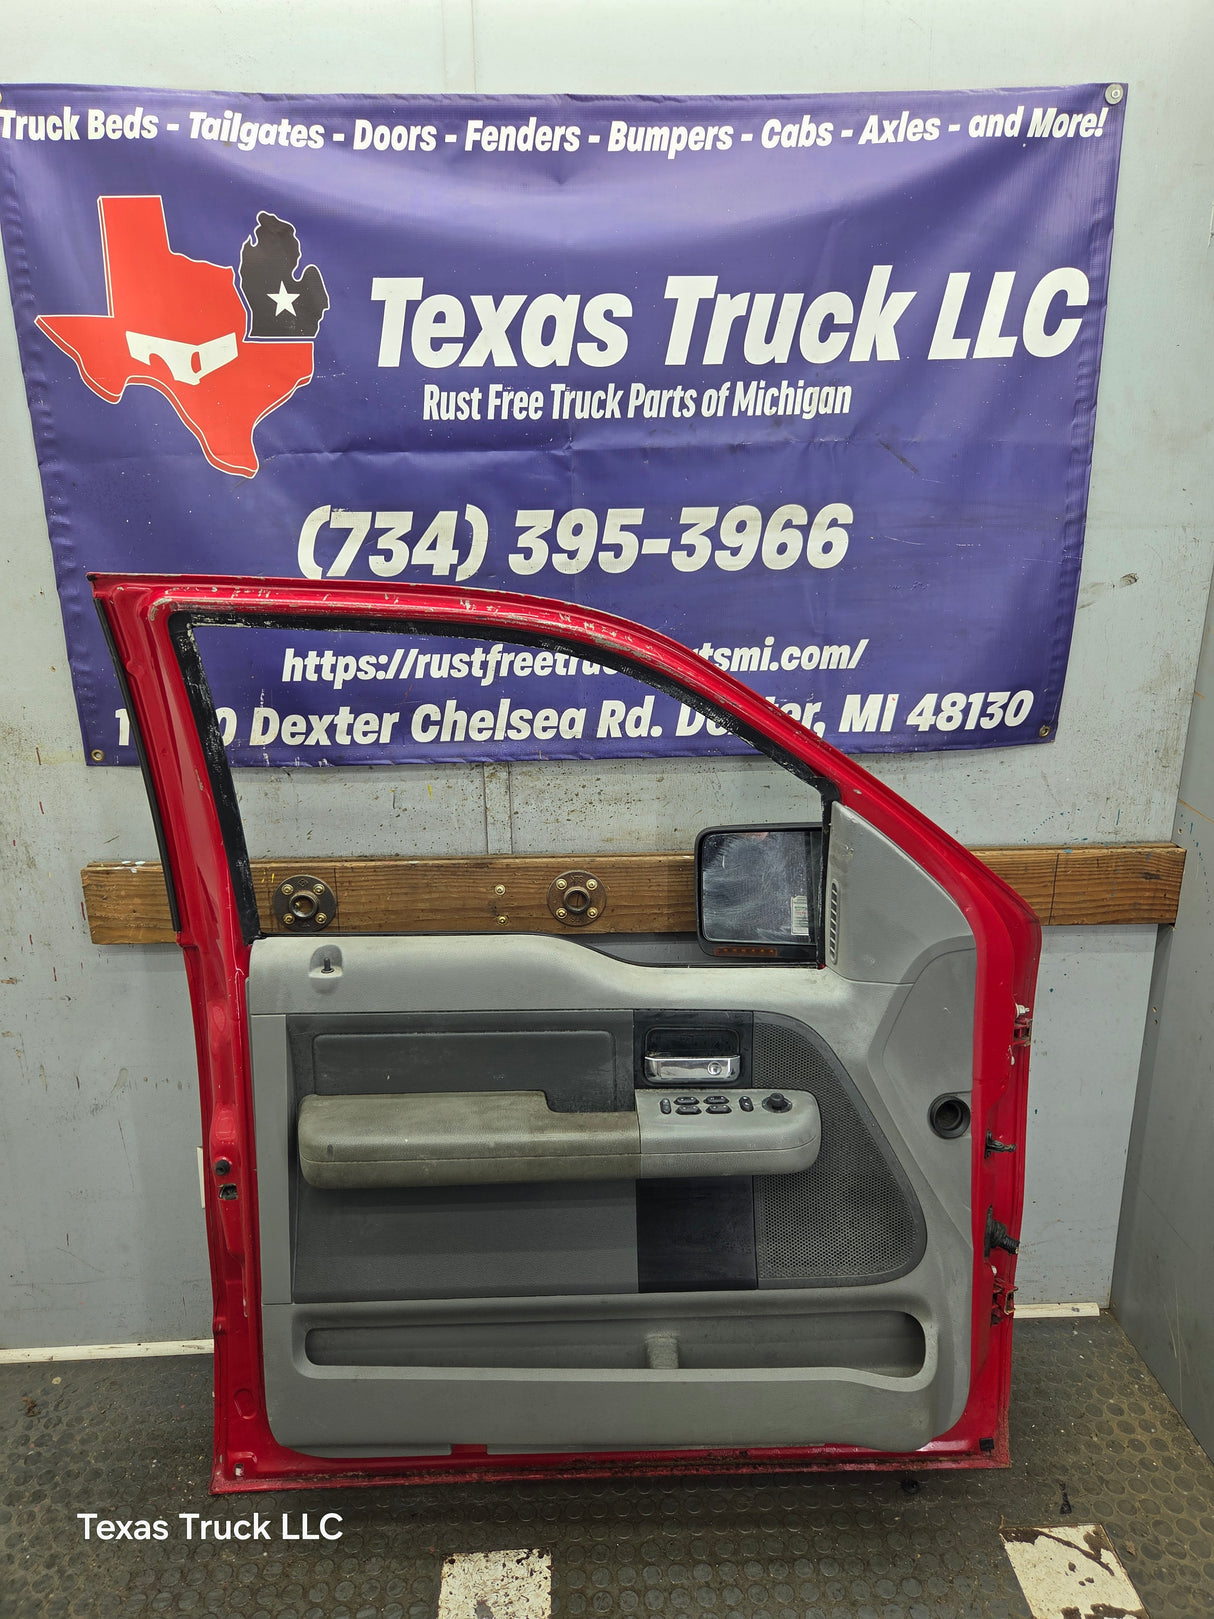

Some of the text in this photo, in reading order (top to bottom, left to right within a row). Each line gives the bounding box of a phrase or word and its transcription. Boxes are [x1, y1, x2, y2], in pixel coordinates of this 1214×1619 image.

[0, 106, 80, 141] Truck
[87, 106, 159, 140] Beds
[189, 110, 325, 151] Tailgates
[353, 119, 437, 151] Doors
[464, 117, 581, 151] Fenders
[607, 120, 734, 160] Bumpers
[761, 114, 834, 149] Cabs
[857, 110, 941, 145] Axles
[968, 105, 1025, 138] and
[1027, 107, 1109, 138] More!
[370, 265, 1089, 368] Texas Truck LLC
[422, 379, 853, 420] Rust Free Truck Parts of Michigan
[297, 502, 854, 581] (734) 395-3966
[249, 704, 400, 746] Dexter
[411, 698, 587, 742] Chelsea
[597, 695, 663, 739] Rd.
[839, 693, 900, 733] MI
[906, 689, 1034, 732] 48130
